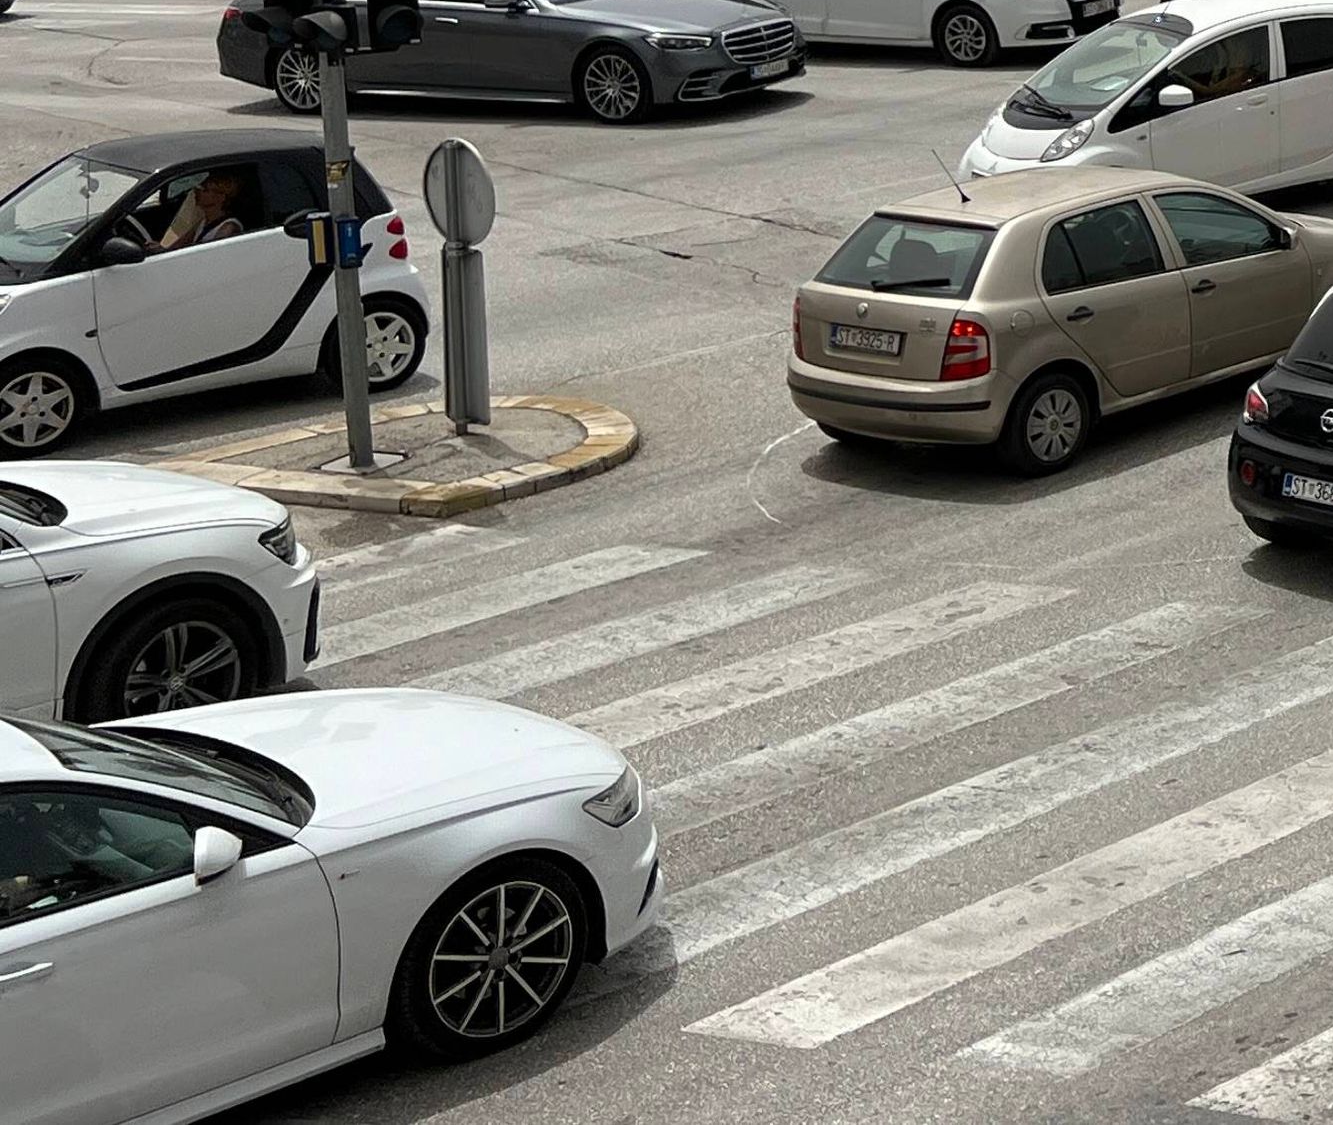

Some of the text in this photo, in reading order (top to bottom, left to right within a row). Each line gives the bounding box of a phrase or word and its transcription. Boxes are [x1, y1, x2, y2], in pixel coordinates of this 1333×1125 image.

[838, 327, 895, 351] ST 3925-R
[1292, 477, 1308, 495] ST
